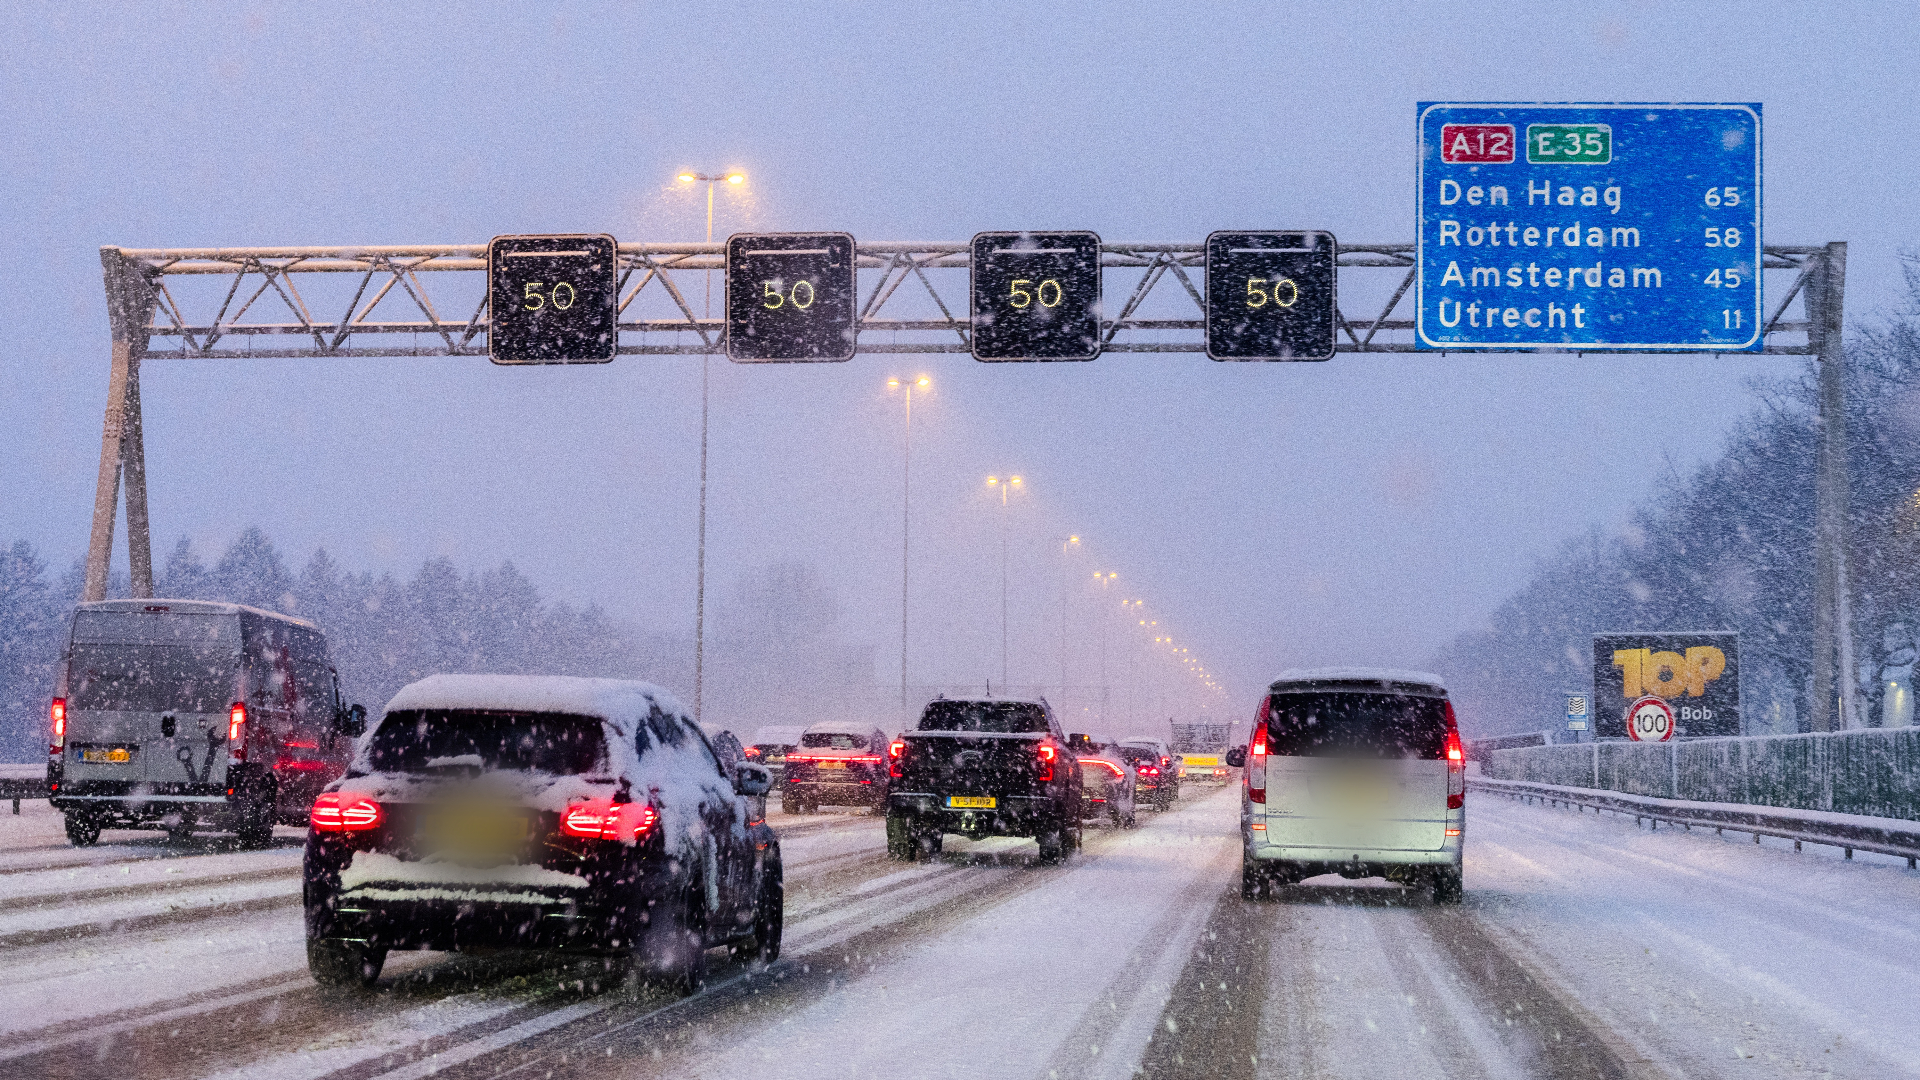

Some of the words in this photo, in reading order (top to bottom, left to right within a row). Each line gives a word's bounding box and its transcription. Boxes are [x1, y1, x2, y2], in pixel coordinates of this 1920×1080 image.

[1449, 132, 1508, 156] A12
[1538, 132, 1555, 155] E
[1564, 132, 1603, 156] 35
[1440, 180, 1508, 206] Den
[1528, 180, 1621, 214] Haag
[1705, 187, 1740, 207] 65
[1439, 220, 1640, 247] Rotterdam
[1705, 228, 1741, 248] 58
[1440, 261, 1662, 288] Amsterdam
[1704, 268, 1741, 288] 45
[525, 282, 574, 310] 50
[764, 281, 815, 309] 50
[1011, 279, 1062, 308] 50
[1247, 279, 1299, 308] 50
[1439, 301, 1586, 328] Utrecht
[1723, 309, 1741, 329] 11
[1637, 714, 1666, 733] 100
[1681, 706, 1713, 720] Bob
